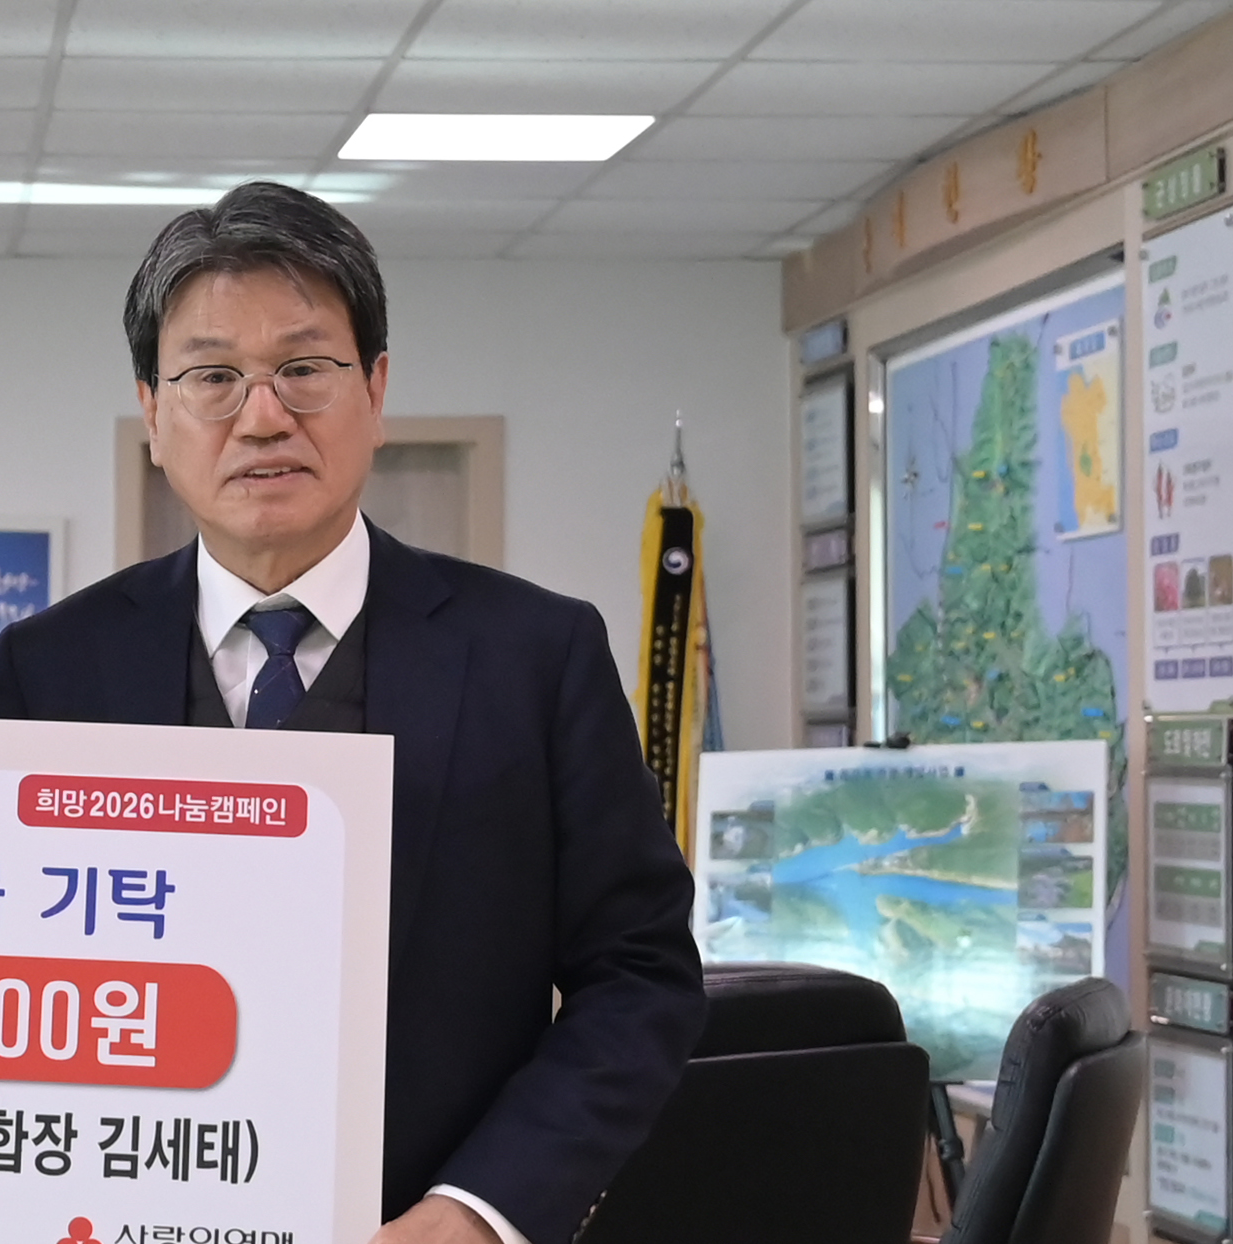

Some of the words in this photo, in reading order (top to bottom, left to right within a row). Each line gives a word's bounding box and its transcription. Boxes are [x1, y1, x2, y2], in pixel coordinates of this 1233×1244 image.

[35, 788, 287, 826] 희망2026나눔캠페인
[40, 866, 176, 940] 기탁
[97, 1114, 260, 1185] 김세태)
